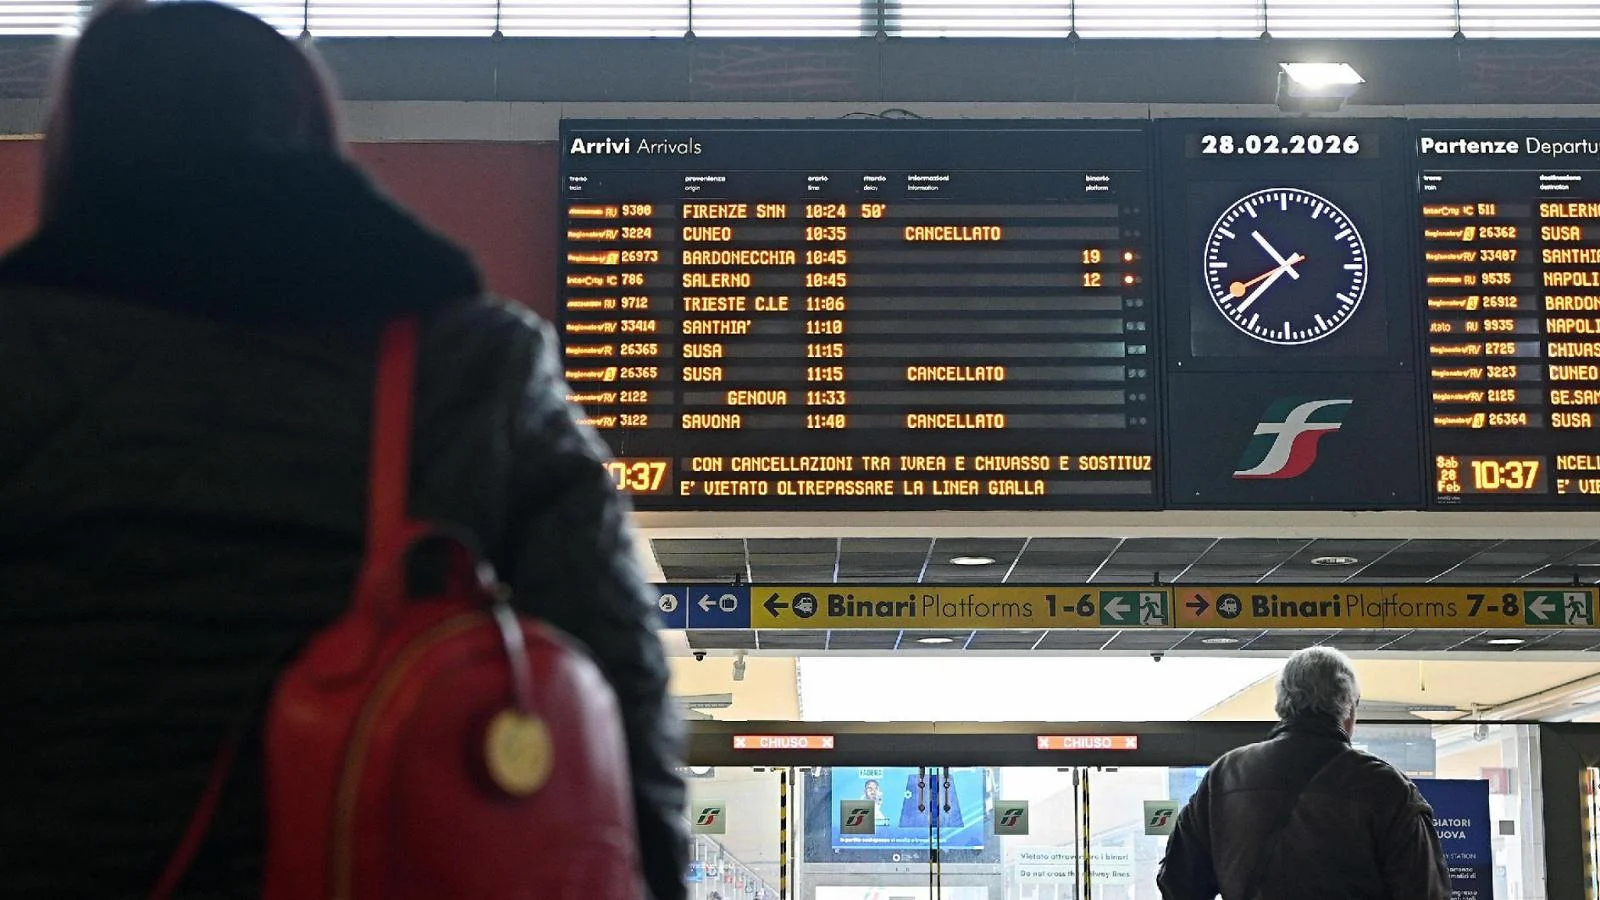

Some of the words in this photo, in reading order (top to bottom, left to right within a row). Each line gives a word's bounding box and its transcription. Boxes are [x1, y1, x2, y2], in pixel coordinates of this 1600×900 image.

[571, 138, 629, 153] Arrivi
[637, 138, 701, 154] Arrivals
[1202, 135, 1359, 154] 28.02.2026
[1421, 138, 1519, 153] Partenze
[1526, 137, 1600, 157] Departu
[623, 205, 651, 216] 9300
[684, 204, 747, 218] FIRENZE
[757, 204, 785, 218] SMN
[806, 204, 846, 218] 10:24
[862, 204, 885, 218] 50'
[1478, 204, 1495, 215] 511
[622, 227, 651, 238] 3224
[683, 227, 731, 241] CUNEO
[806, 227, 846, 240] 10:35
[906, 227, 1000, 240] CANCELLATO
[1479, 227, 1516, 238] 26362
[1542, 226, 1580, 240] SUSA
[622, 251, 658, 261] 26973
[683, 251, 795, 264] BARDONECCHIA
[807, 250, 846, 264] 10:45
[1083, 250, 1100, 263] 19
[1480, 250, 1516, 261] 33407
[622, 274, 643, 285] 786
[683, 273, 750, 287] SALERNO
[806, 273, 846, 287] 10:45
[1084, 273, 1100, 286] 12
[1482, 273, 1511, 284] 9535
[1544, 272, 1599, 286] NAPOLI
[622, 297, 647, 308] 9712
[683, 297, 745, 311] TRIESTE
[755, 297, 788, 311] C.LE
[807, 297, 844, 310] 11:06
[1483, 296, 1517, 307] 26912
[621, 320, 655, 331] 33414
[683, 320, 751, 334] SANTHIA'
[807, 320, 842, 334] 11:10
[1484, 320, 1513, 331] 9935
[1547, 319, 1600, 333] NAPOLI
[621, 344, 657, 355] 26365
[683, 344, 722, 357] SUSA
[808, 344, 842, 357] 11:15
[1486, 343, 1515, 354] 2725
[1548, 343, 1600, 357] CHIVAS
[621, 367, 657, 378] 26365
[683, 367, 721, 381] SUSA
[808, 367, 843, 381] 11:15
[908, 367, 1004, 381] CANCELLATO
[1487, 366, 1516, 377] 3223
[1549, 365, 1598, 380] CUNEO
[620, 391, 647, 402] 2122
[728, 391, 786, 405] GENOVA
[808, 391, 845, 405] 11:33
[1488, 390, 1515, 401] 2125
[620, 414, 647, 425] 3122
[683, 415, 740, 428] SAVONA
[807, 415, 845, 428] 11:40
[907, 414, 1004, 428] CANCELLATO
[1489, 413, 1526, 425] 26364
[1552, 413, 1591, 427] SUSA
[693, 457, 722, 471] CON
[732, 457, 852, 471] CANCELLAZIONI
[862, 457, 890, 470] TRA
[901, 456, 945, 470] IVREA
[955, 456, 964, 470] E
[975, 456, 1049, 470] CHIVASSO
[1060, 456, 1069, 470] E
[1079, 456, 1151, 470] SOSTITUZ
[1436, 455, 1460, 468] Sab
[601, 462, 667, 491] 0:37
[1440, 468, 1458, 481] 28
[1472, 461, 1539, 489] 10:37
[681, 481, 695, 495] E'
[704, 481, 767, 495] VIETATO
[778, 481, 893, 495] OLTREPASSARE
[904, 481, 923, 495] LA
[933, 481, 978, 495] LINEA
[989, 480, 1044, 495] GIALLA
[1437, 480, 1461, 492] Feb
[1557, 479, 1569, 493] E'
[827, 593, 917, 618] Binari
[921, 594, 1033, 618] Platforms
[1045, 594, 1096, 617] 1-6
[1251, 594, 1341, 618] Binari
[1346, 594, 1458, 618] Platforms
[1466, 594, 1521, 617] 7-8
[759, 736, 809, 749] CHIUSO
[1063, 736, 1112, 749] CHIUSO
[1431, 819, 1471, 827] GIATORI
[1436, 831, 1466, 839] UOVA
[1105, 853, 1129, 861] binari
